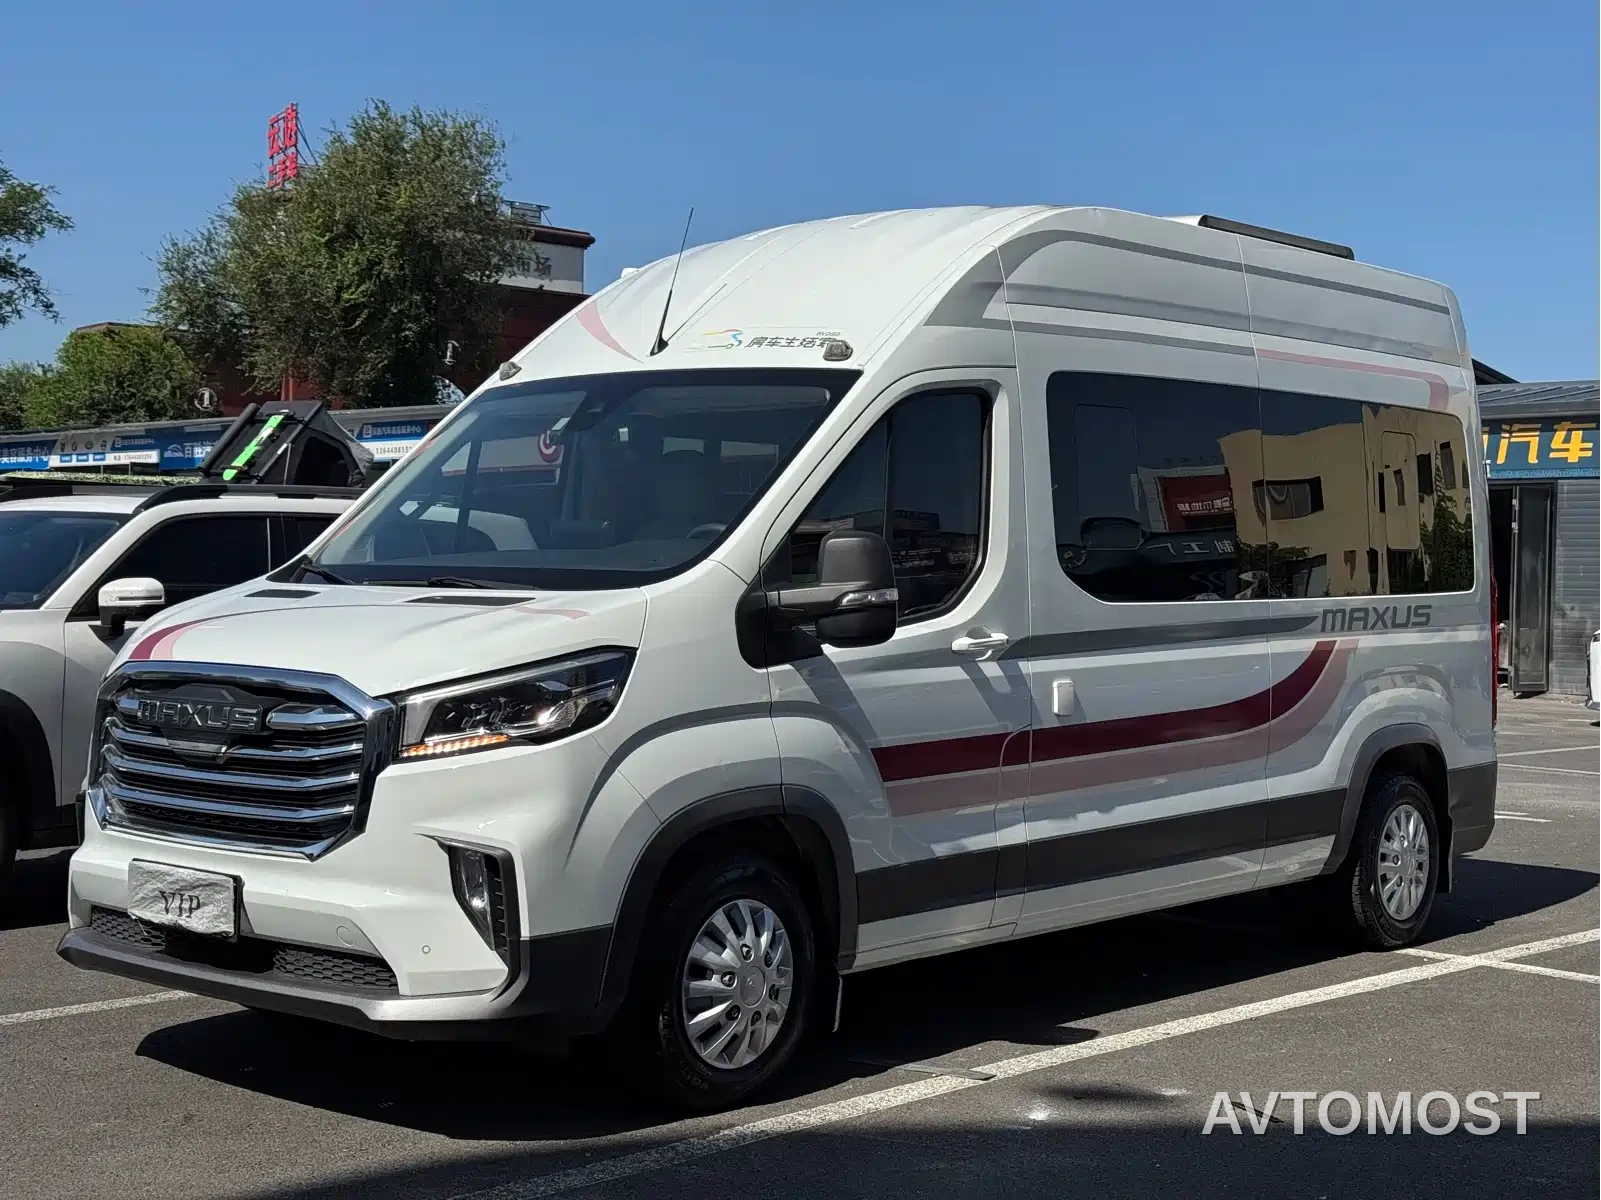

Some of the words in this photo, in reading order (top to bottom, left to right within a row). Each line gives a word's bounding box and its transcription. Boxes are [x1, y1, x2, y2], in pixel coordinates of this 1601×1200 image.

[0, 445, 50, 464] 美容服务中心
[1482, 421, 1597, 465] 汽车
[1320, 604, 1432, 632] MAXUS
[137, 700, 260, 731] MAXUS
[160, 890, 201, 919] VIP
